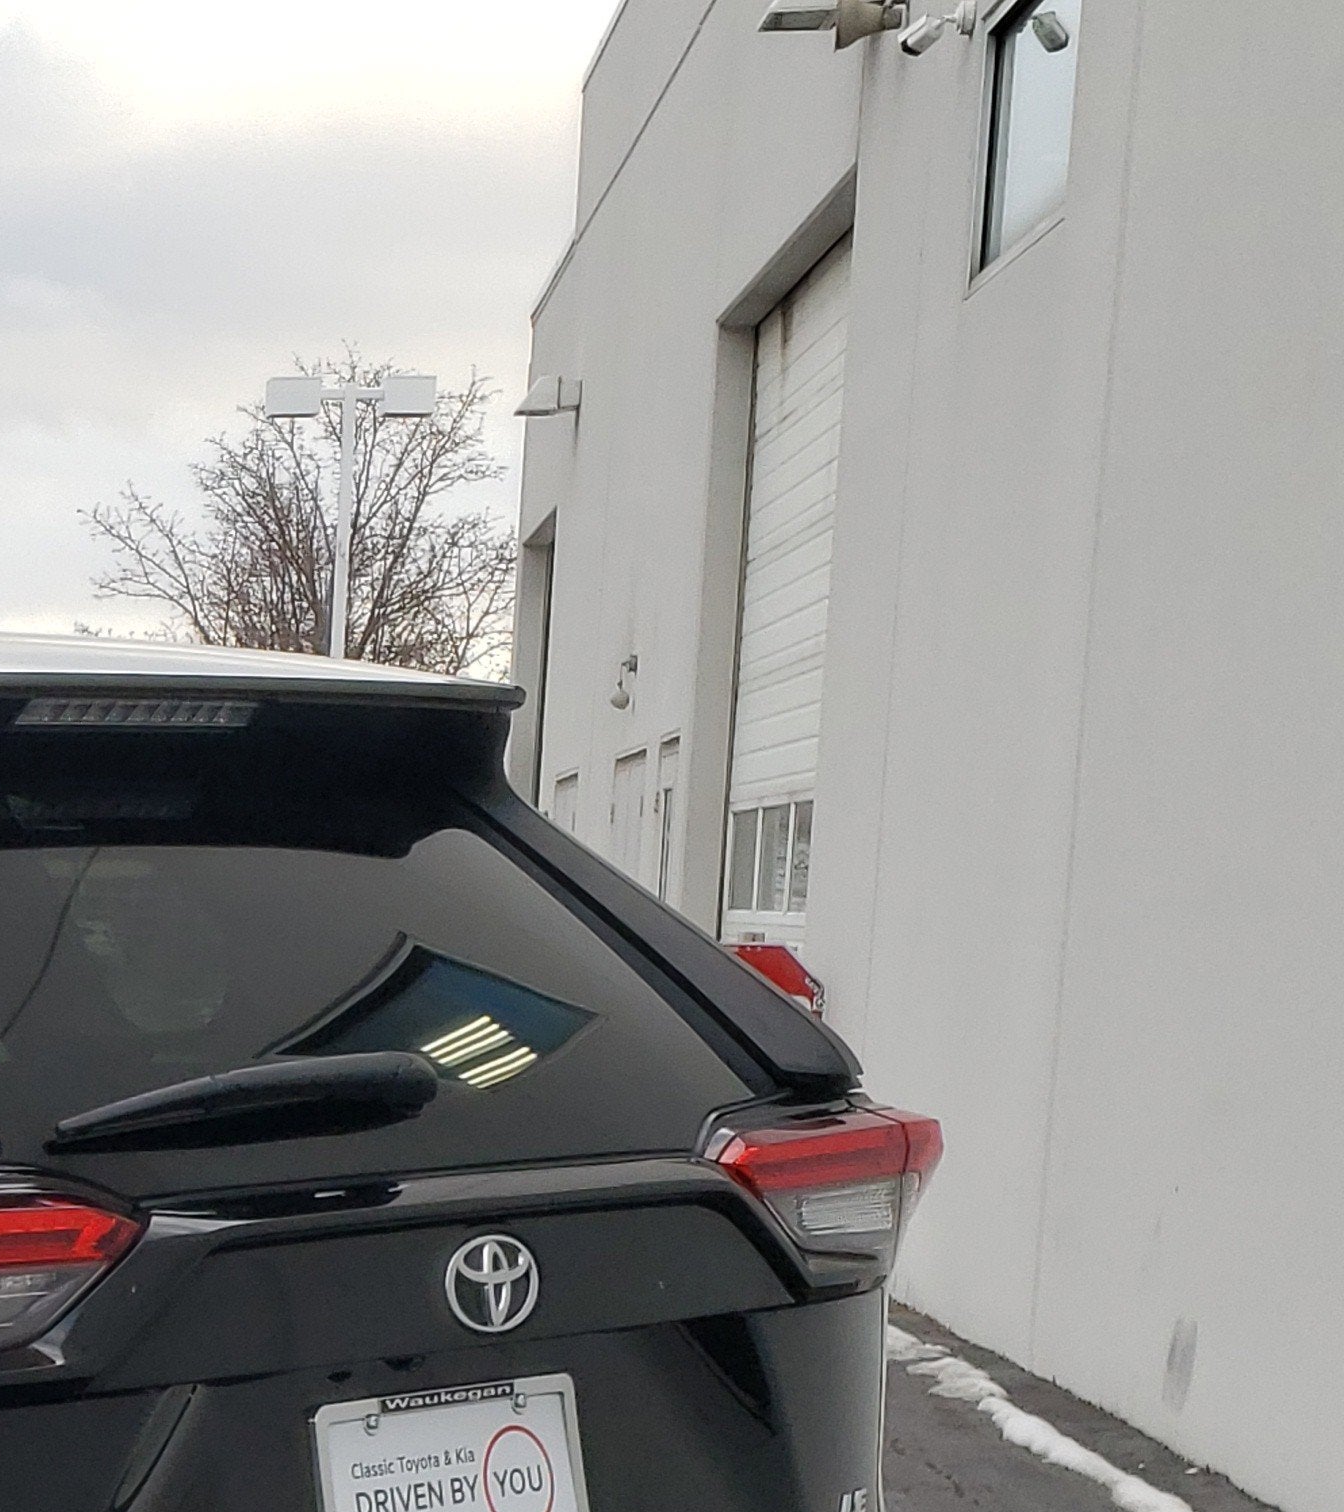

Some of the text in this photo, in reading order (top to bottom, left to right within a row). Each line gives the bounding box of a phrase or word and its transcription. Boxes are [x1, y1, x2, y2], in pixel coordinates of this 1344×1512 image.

[384, 1384, 512, 1410] Waukegan
[351, 1447, 476, 1480] Classic Toyota & Kia
[451, 1473, 480, 1505] BY
[493, 1464, 544, 1498] YOU
